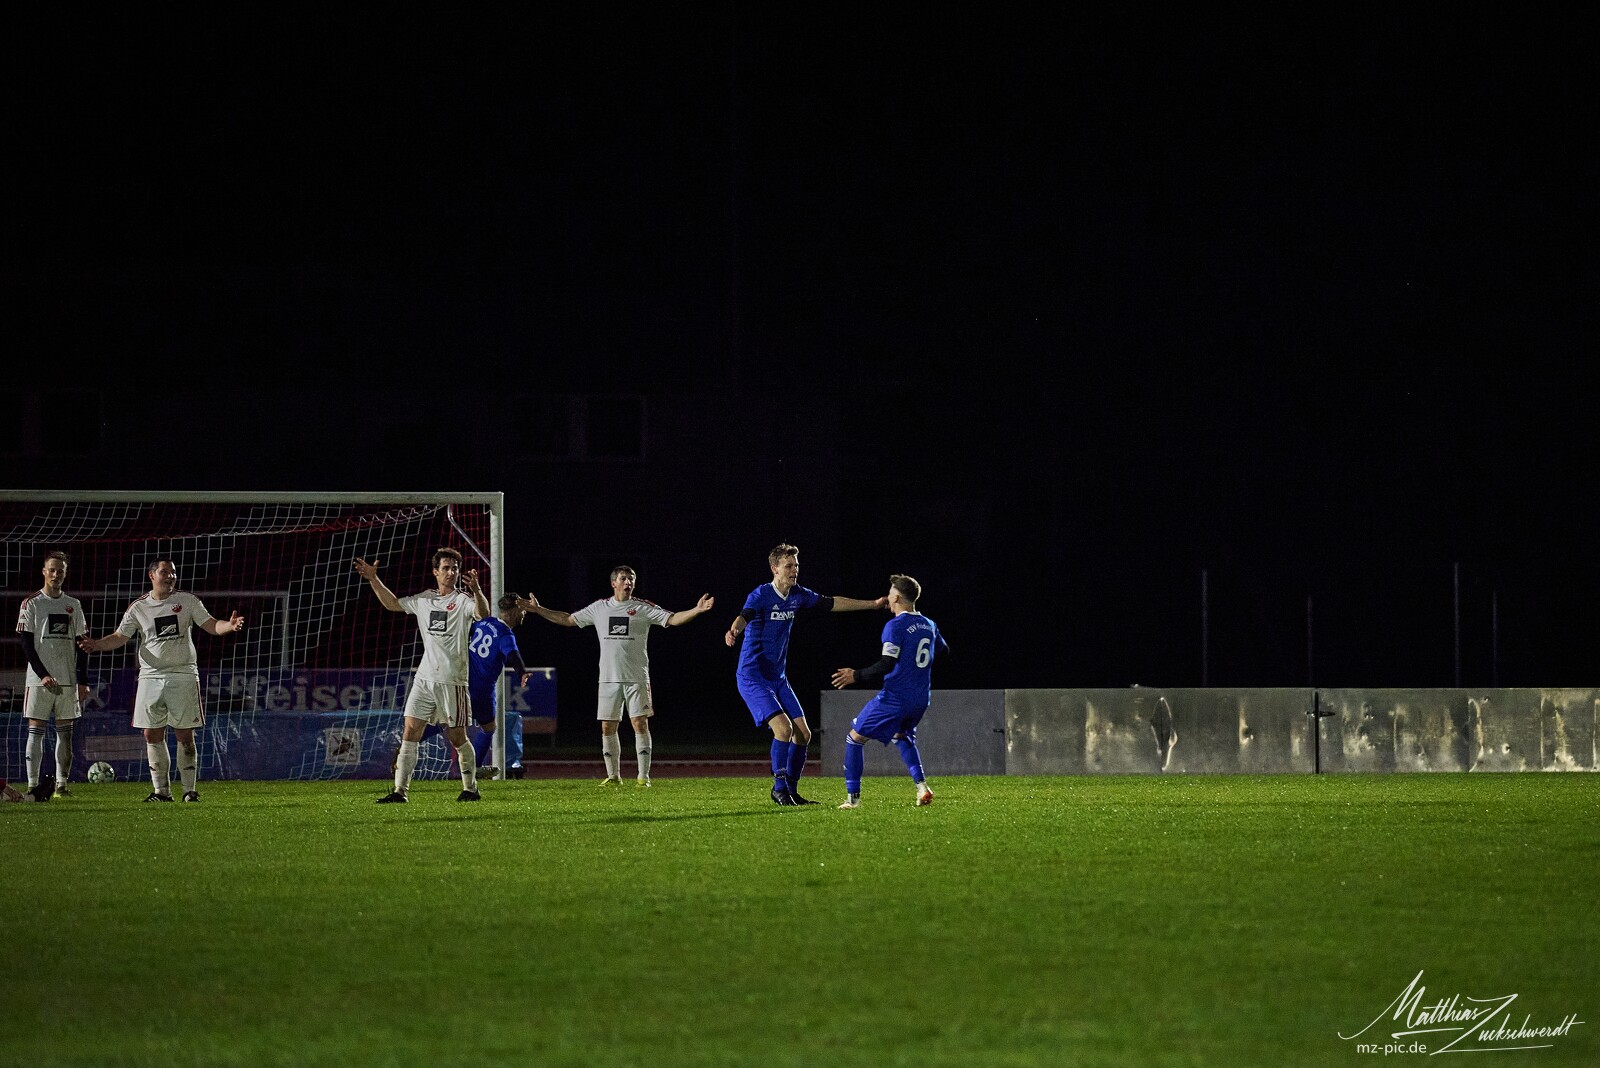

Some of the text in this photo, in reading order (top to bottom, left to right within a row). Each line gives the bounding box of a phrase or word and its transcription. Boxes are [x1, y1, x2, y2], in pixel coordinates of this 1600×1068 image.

[468, 627, 493, 659] 28
[915, 637, 931, 668] 6
[207, 675, 532, 712] iffeisenk
